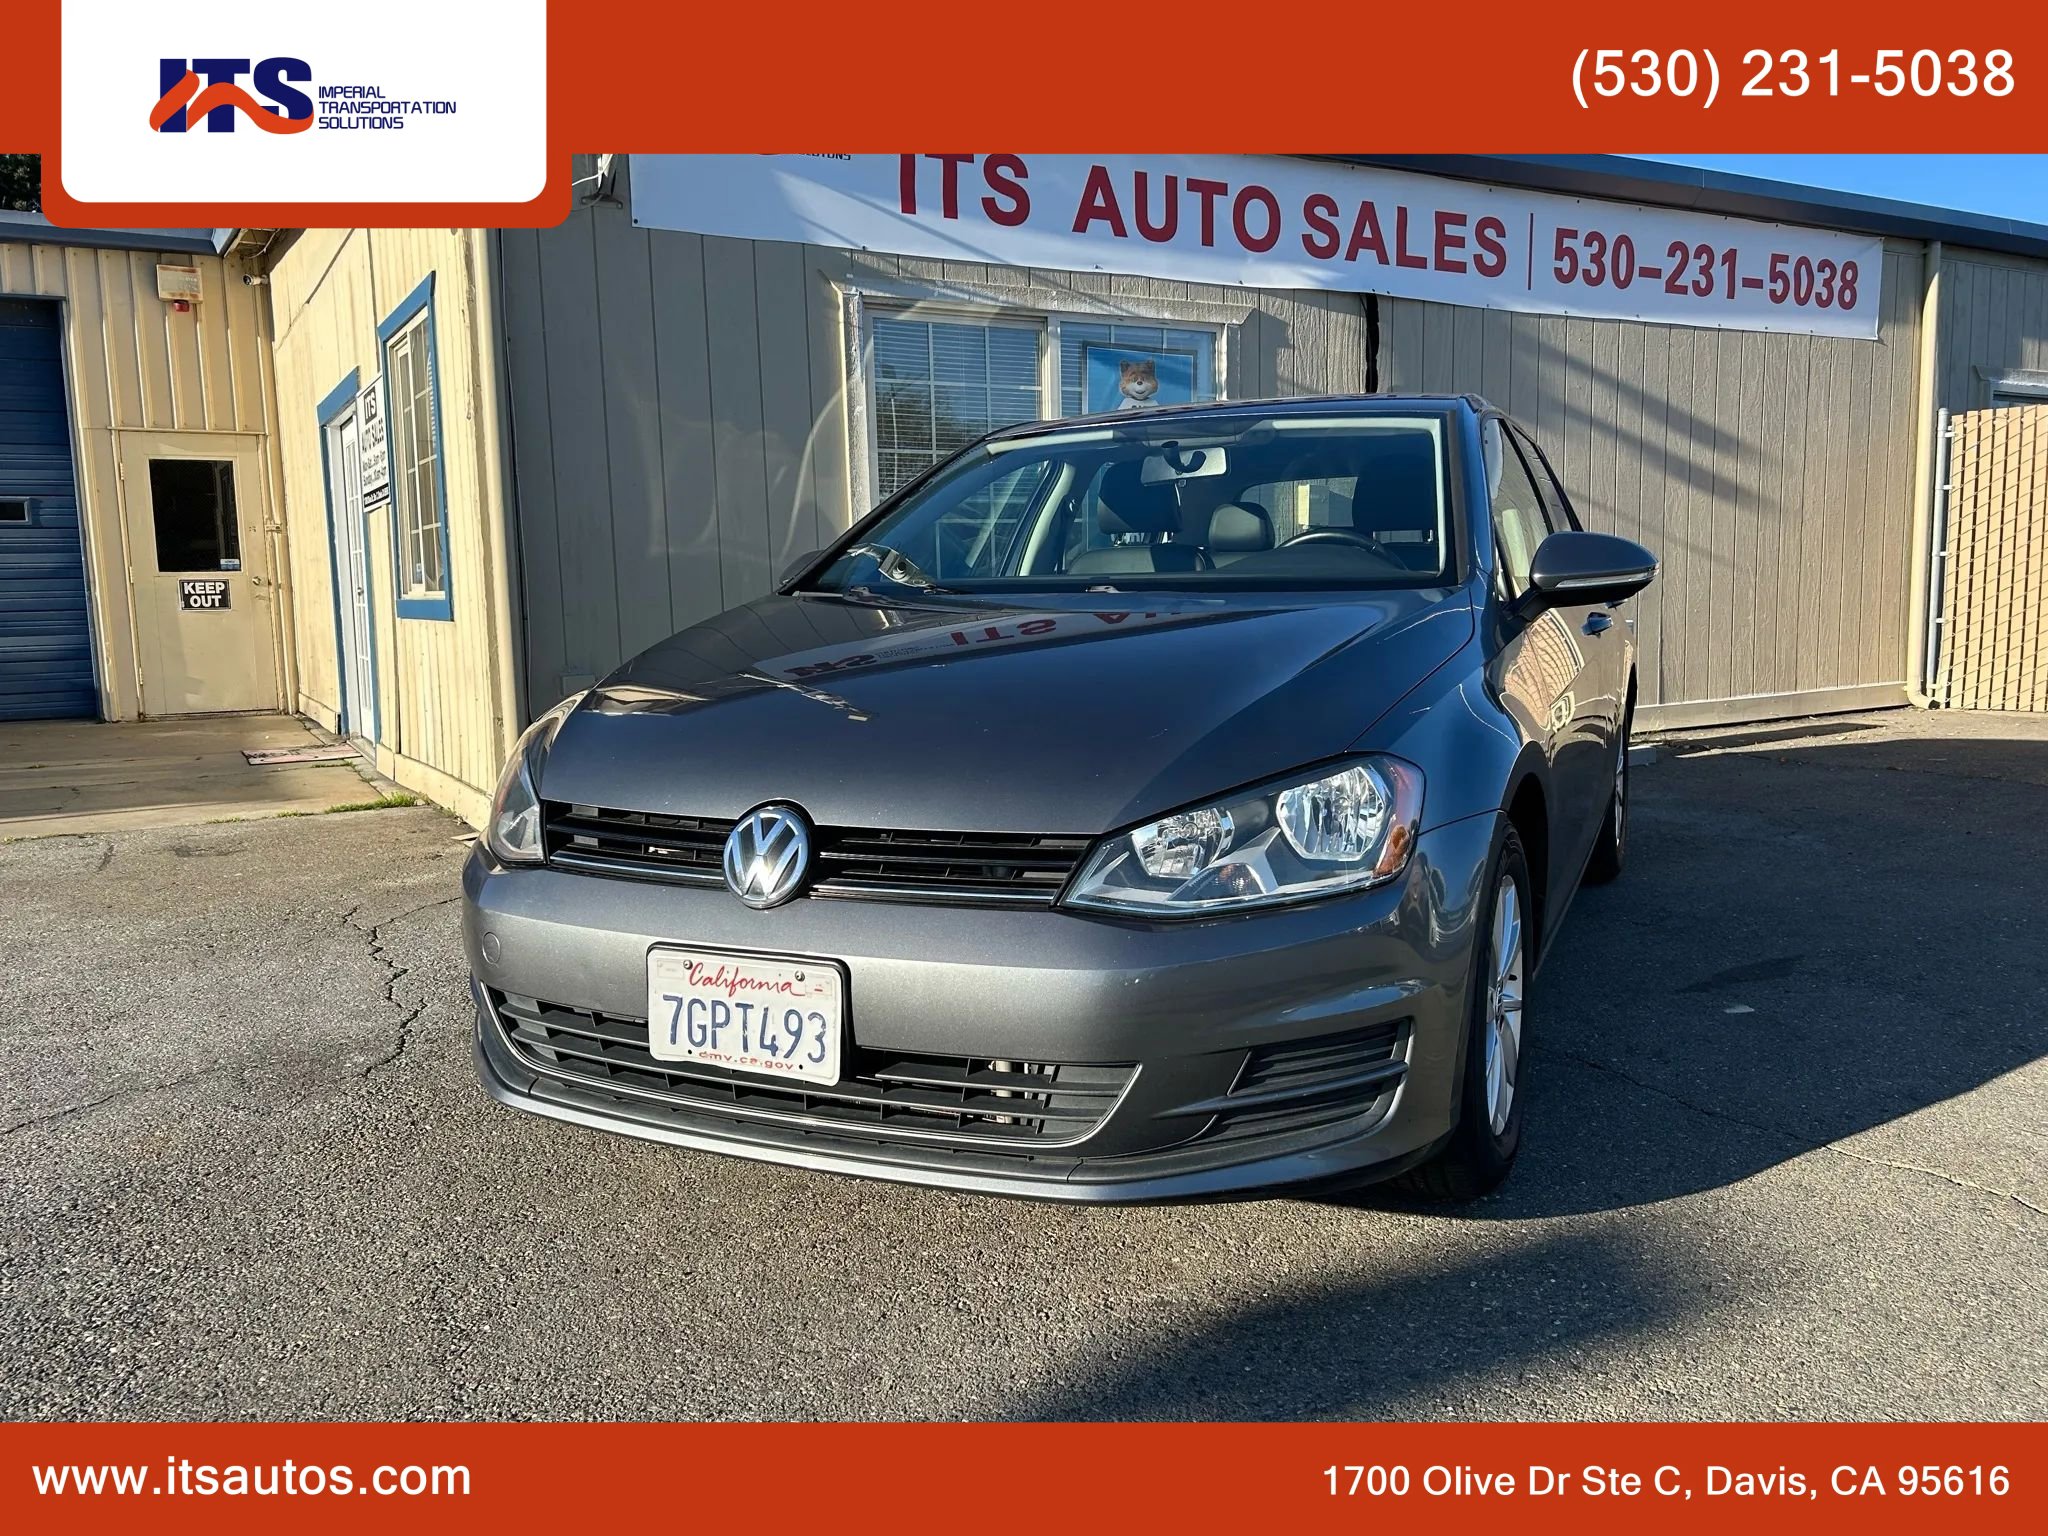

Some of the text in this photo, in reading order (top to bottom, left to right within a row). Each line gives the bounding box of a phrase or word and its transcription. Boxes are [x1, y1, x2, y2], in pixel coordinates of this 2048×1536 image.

[899, 153, 1858, 310] ITS AUTO SALES 530-231-5038
[183, 582, 225, 594] KEEP
[190, 595, 222, 607] OUT
[688, 962, 805, 998] California
[661, 993, 827, 1064] 7GPT493
[698, 1050, 795, 1071] dmv.ca.gov
